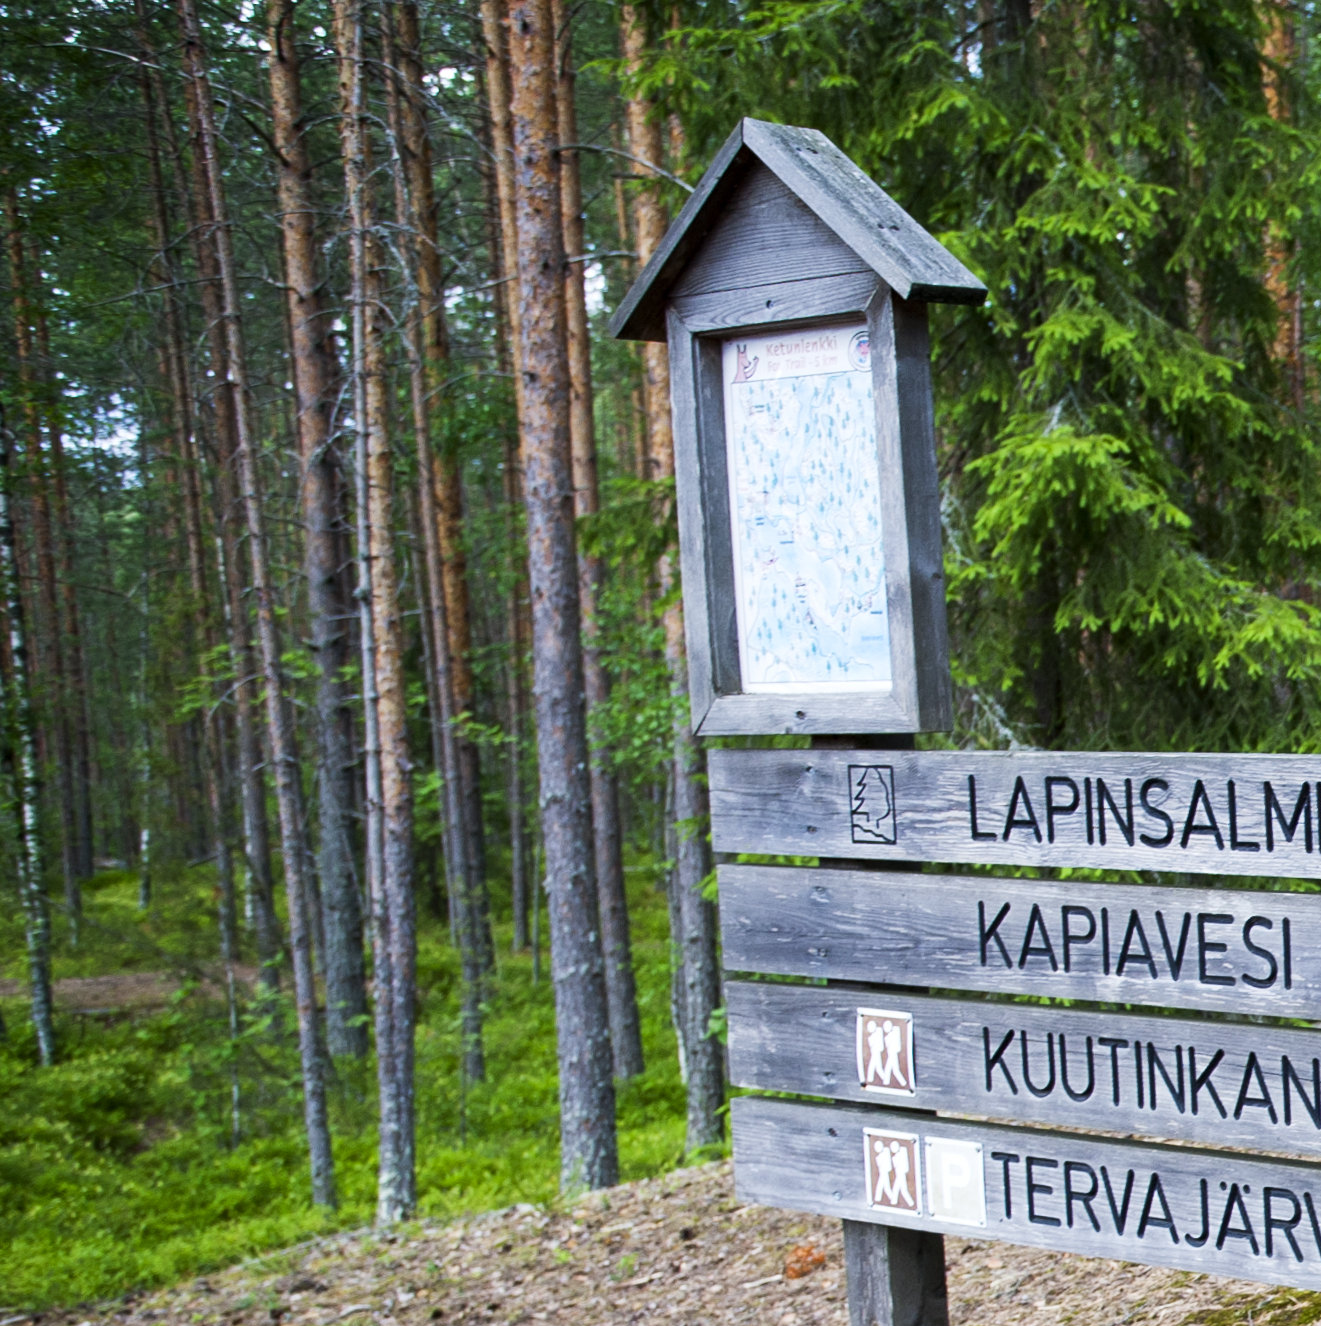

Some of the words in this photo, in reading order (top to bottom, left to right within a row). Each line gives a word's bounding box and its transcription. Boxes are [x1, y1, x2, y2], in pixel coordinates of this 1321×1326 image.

[765, 334, 838, 357] Ketunlenkki
[823, 354, 838, 366] km
[977, 900, 1292, 991] KAPIAVESI
[941, 1152, 970, 1209] P
